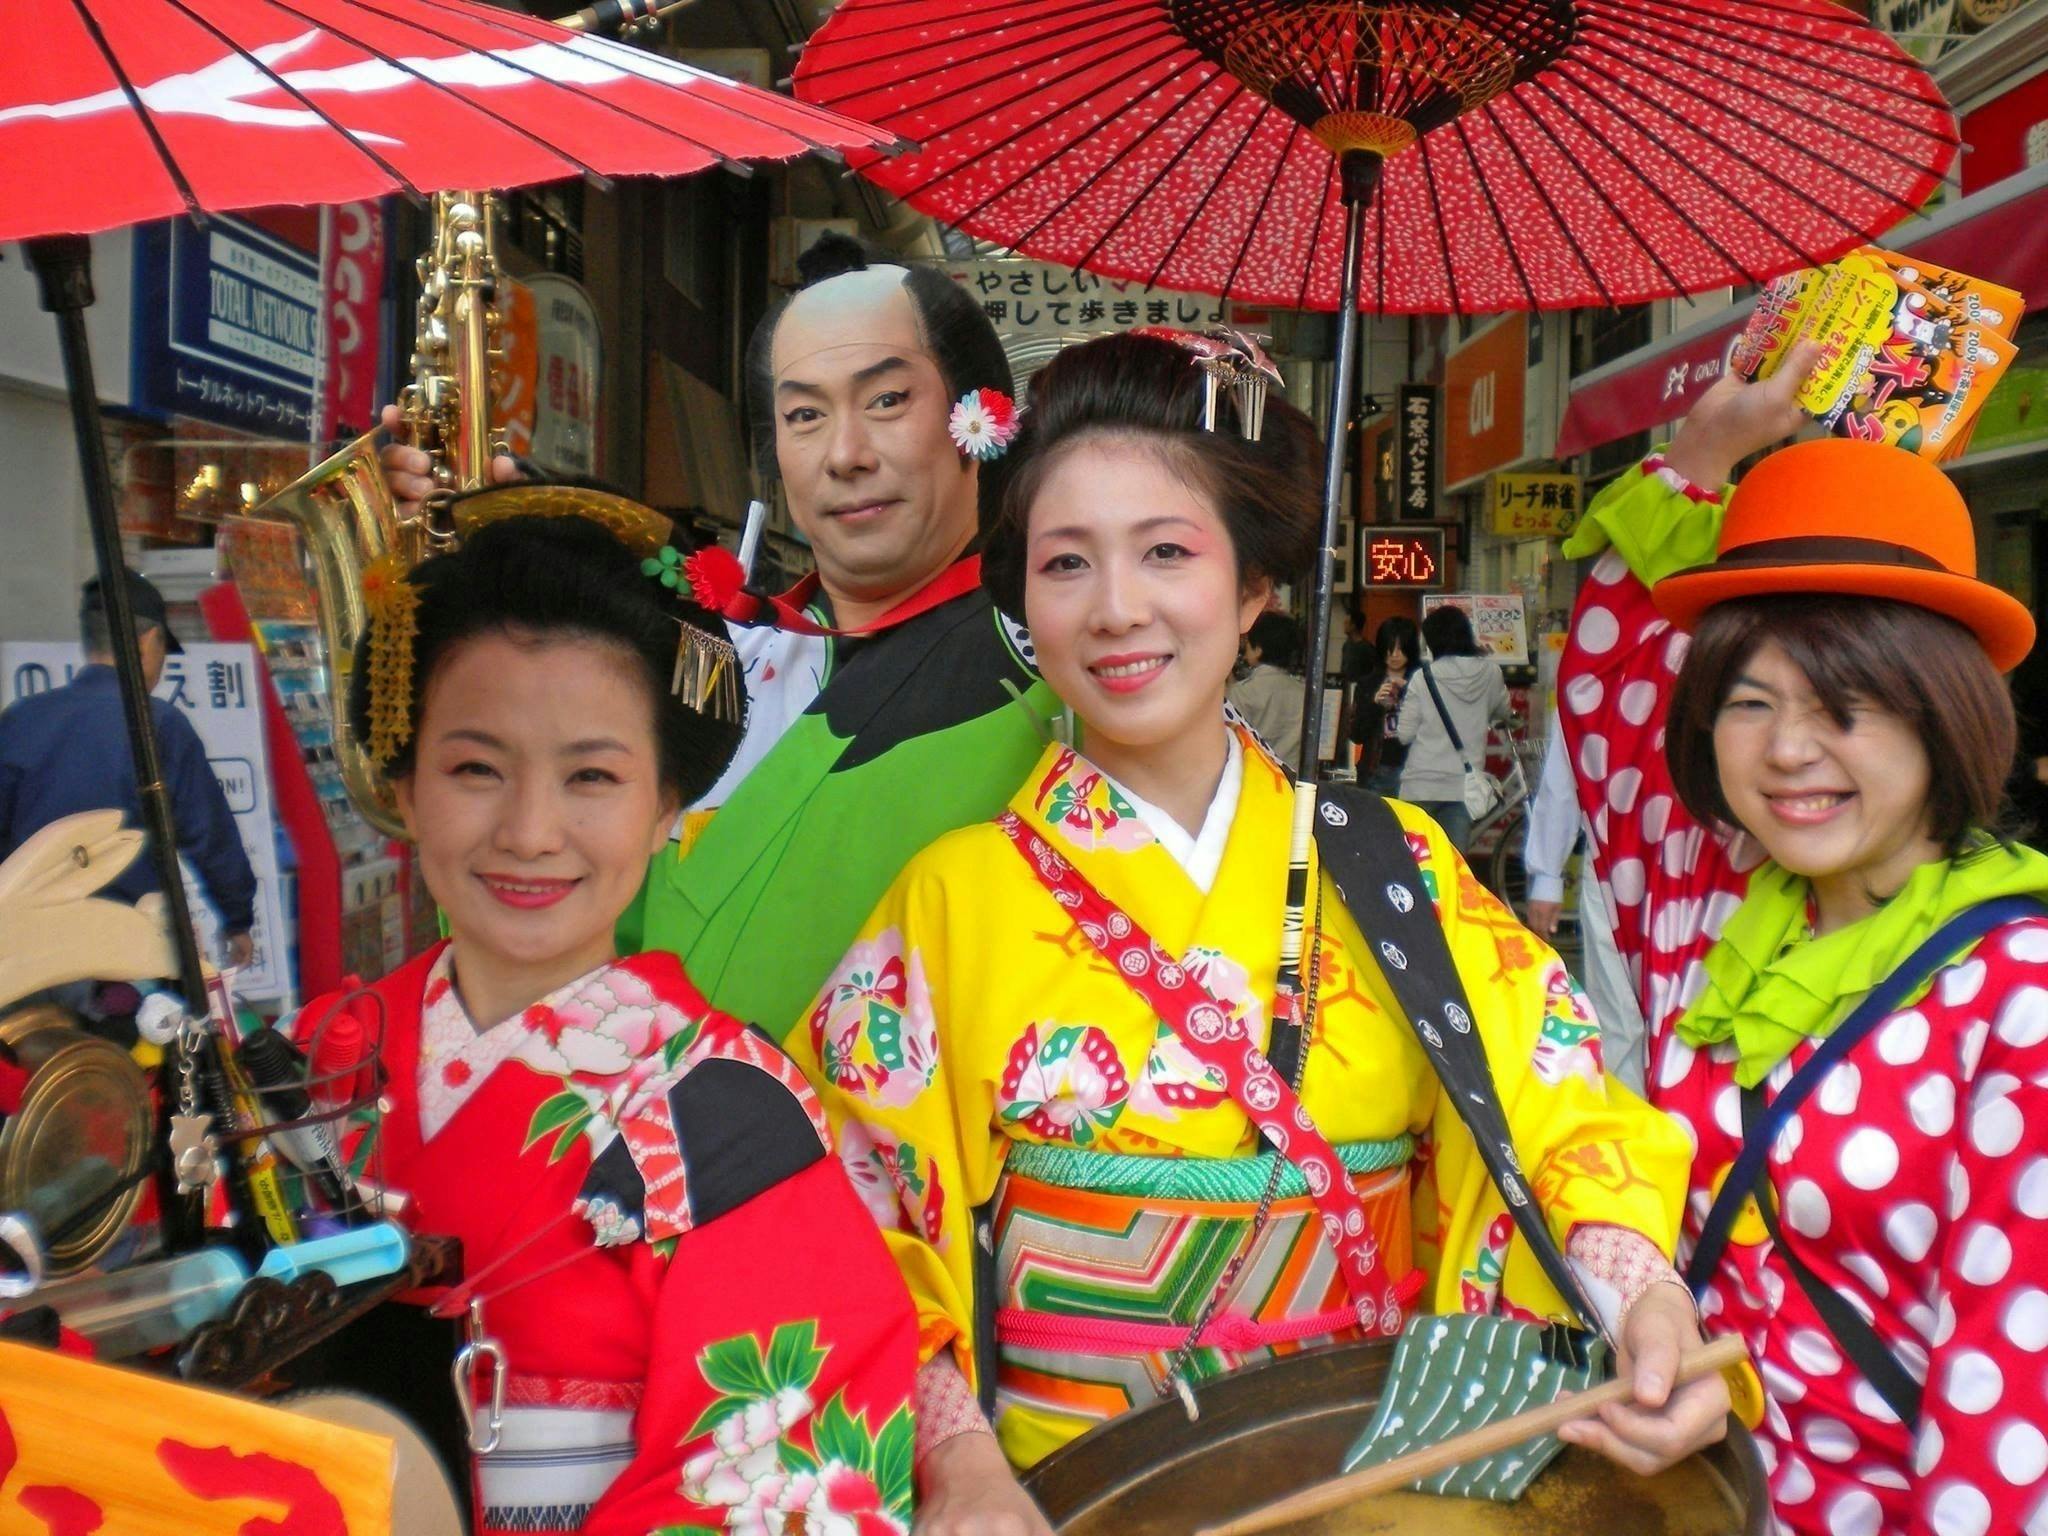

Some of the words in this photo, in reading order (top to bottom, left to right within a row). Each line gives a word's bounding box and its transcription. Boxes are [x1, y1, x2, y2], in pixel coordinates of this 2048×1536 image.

[210, 269, 249, 328] TOTAL
[252, 287, 309, 353] NETWORK
[1966, 331, 1980, 363] 2009
[1500, 481, 1576, 509] リーチ麻雀
[1372, 539, 1435, 580] 安心
